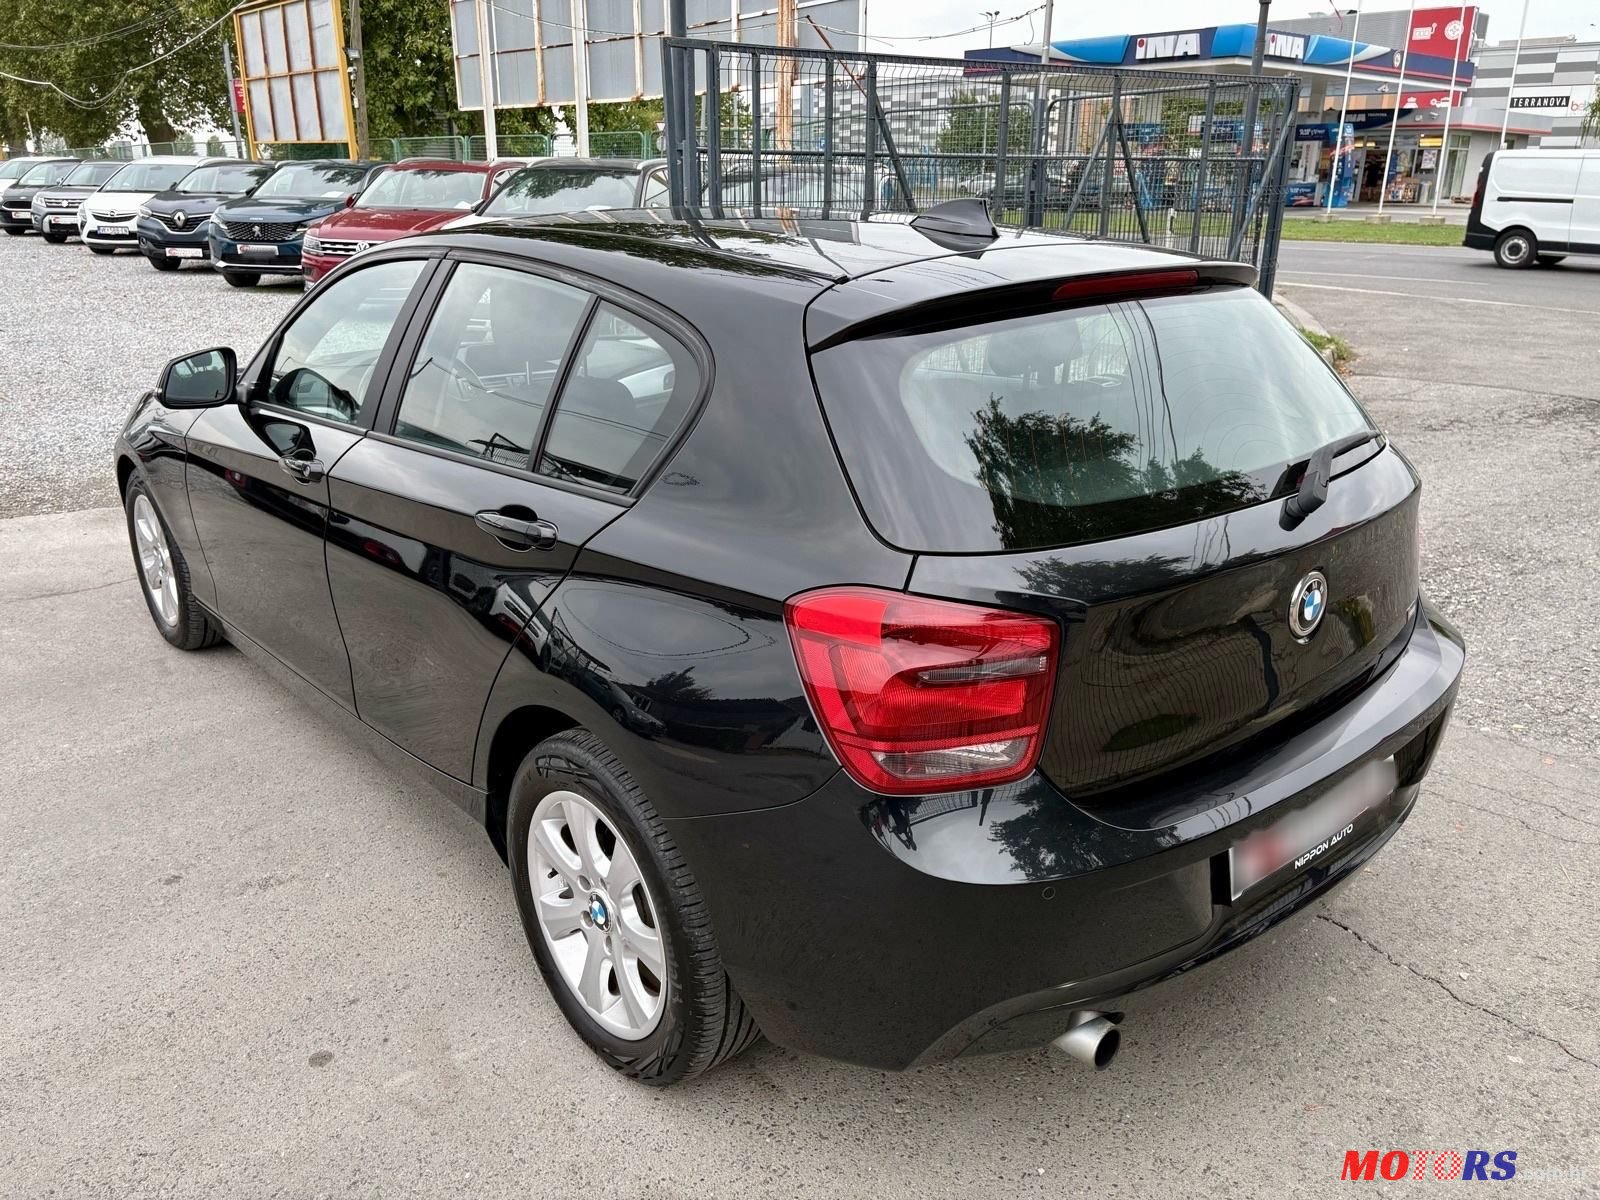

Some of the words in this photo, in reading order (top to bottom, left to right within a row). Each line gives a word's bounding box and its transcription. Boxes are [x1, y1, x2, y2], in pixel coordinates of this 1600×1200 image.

[1513, 97, 1567, 107] TERRANOVA
[1294, 840, 1329, 870] NIPPON
[1330, 823, 1354, 846] AUTO
